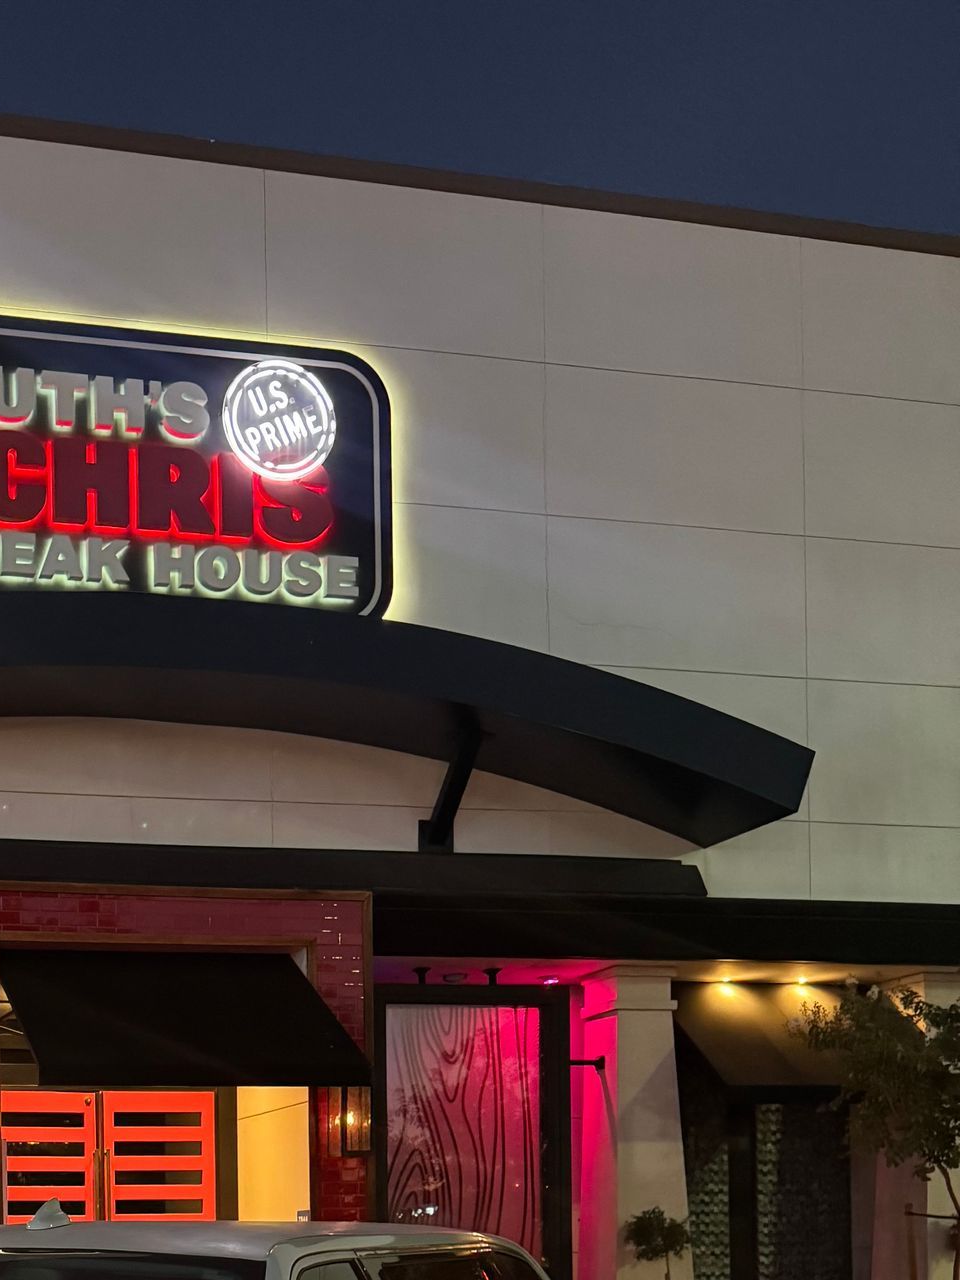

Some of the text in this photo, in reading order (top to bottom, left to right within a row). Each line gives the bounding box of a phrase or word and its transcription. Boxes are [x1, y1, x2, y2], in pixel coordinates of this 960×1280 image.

[247, 380, 296, 417] U.S.
[244, 404, 323, 456] PRIME
[151, 541, 360, 600] HOUSE
